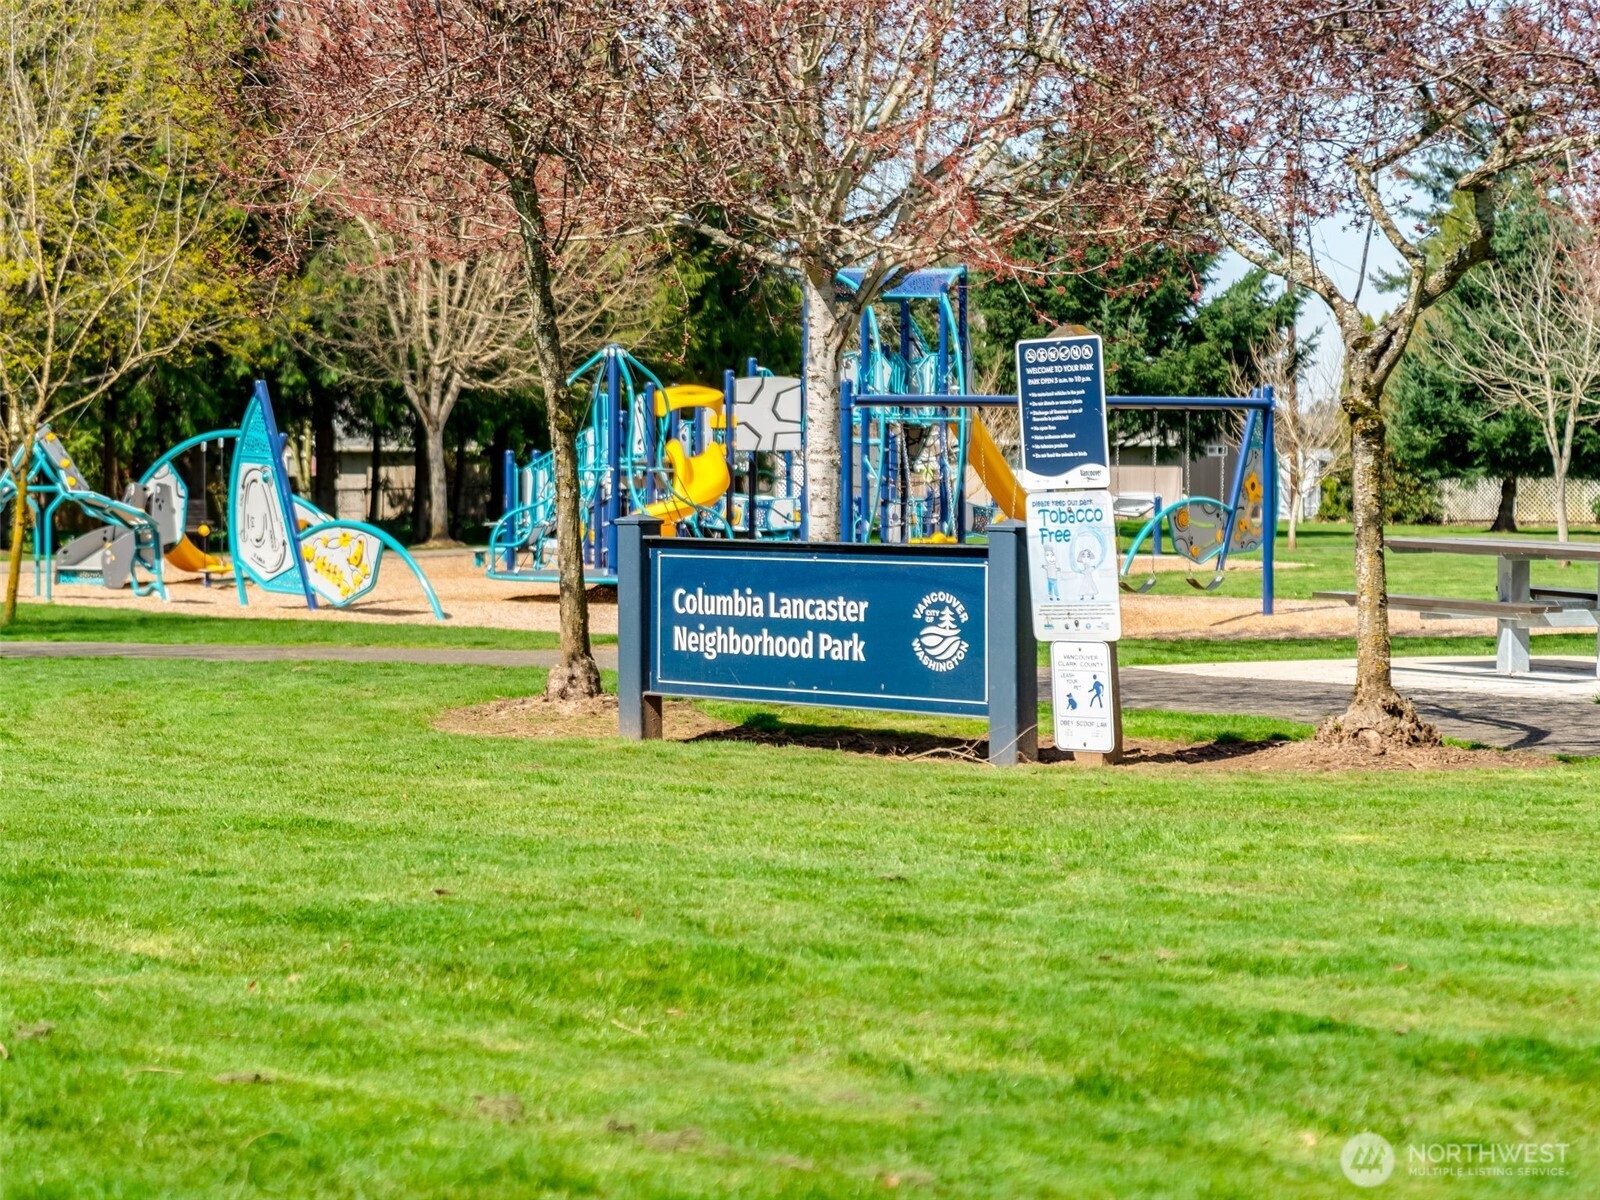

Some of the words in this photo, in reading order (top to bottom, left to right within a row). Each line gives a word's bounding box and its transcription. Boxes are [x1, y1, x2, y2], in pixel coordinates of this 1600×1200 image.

[1026, 366, 1054, 374] WELCOME
[1055, 365, 1063, 373] TO
[1063, 364, 1080, 372] YOUR
[1080, 363, 1094, 371] PARK
[1038, 508, 1104, 526] Tobacco
[1038, 528, 1072, 545] Free
[673, 587, 764, 618] Columbia
[768, 592, 868, 622] Lancaster
[912, 591, 969, 624] VANCOUVER
[673, 624, 814, 660] Neighborhood
[818, 632, 866, 662] Park
[911, 638, 970, 672] WASHINGTON
